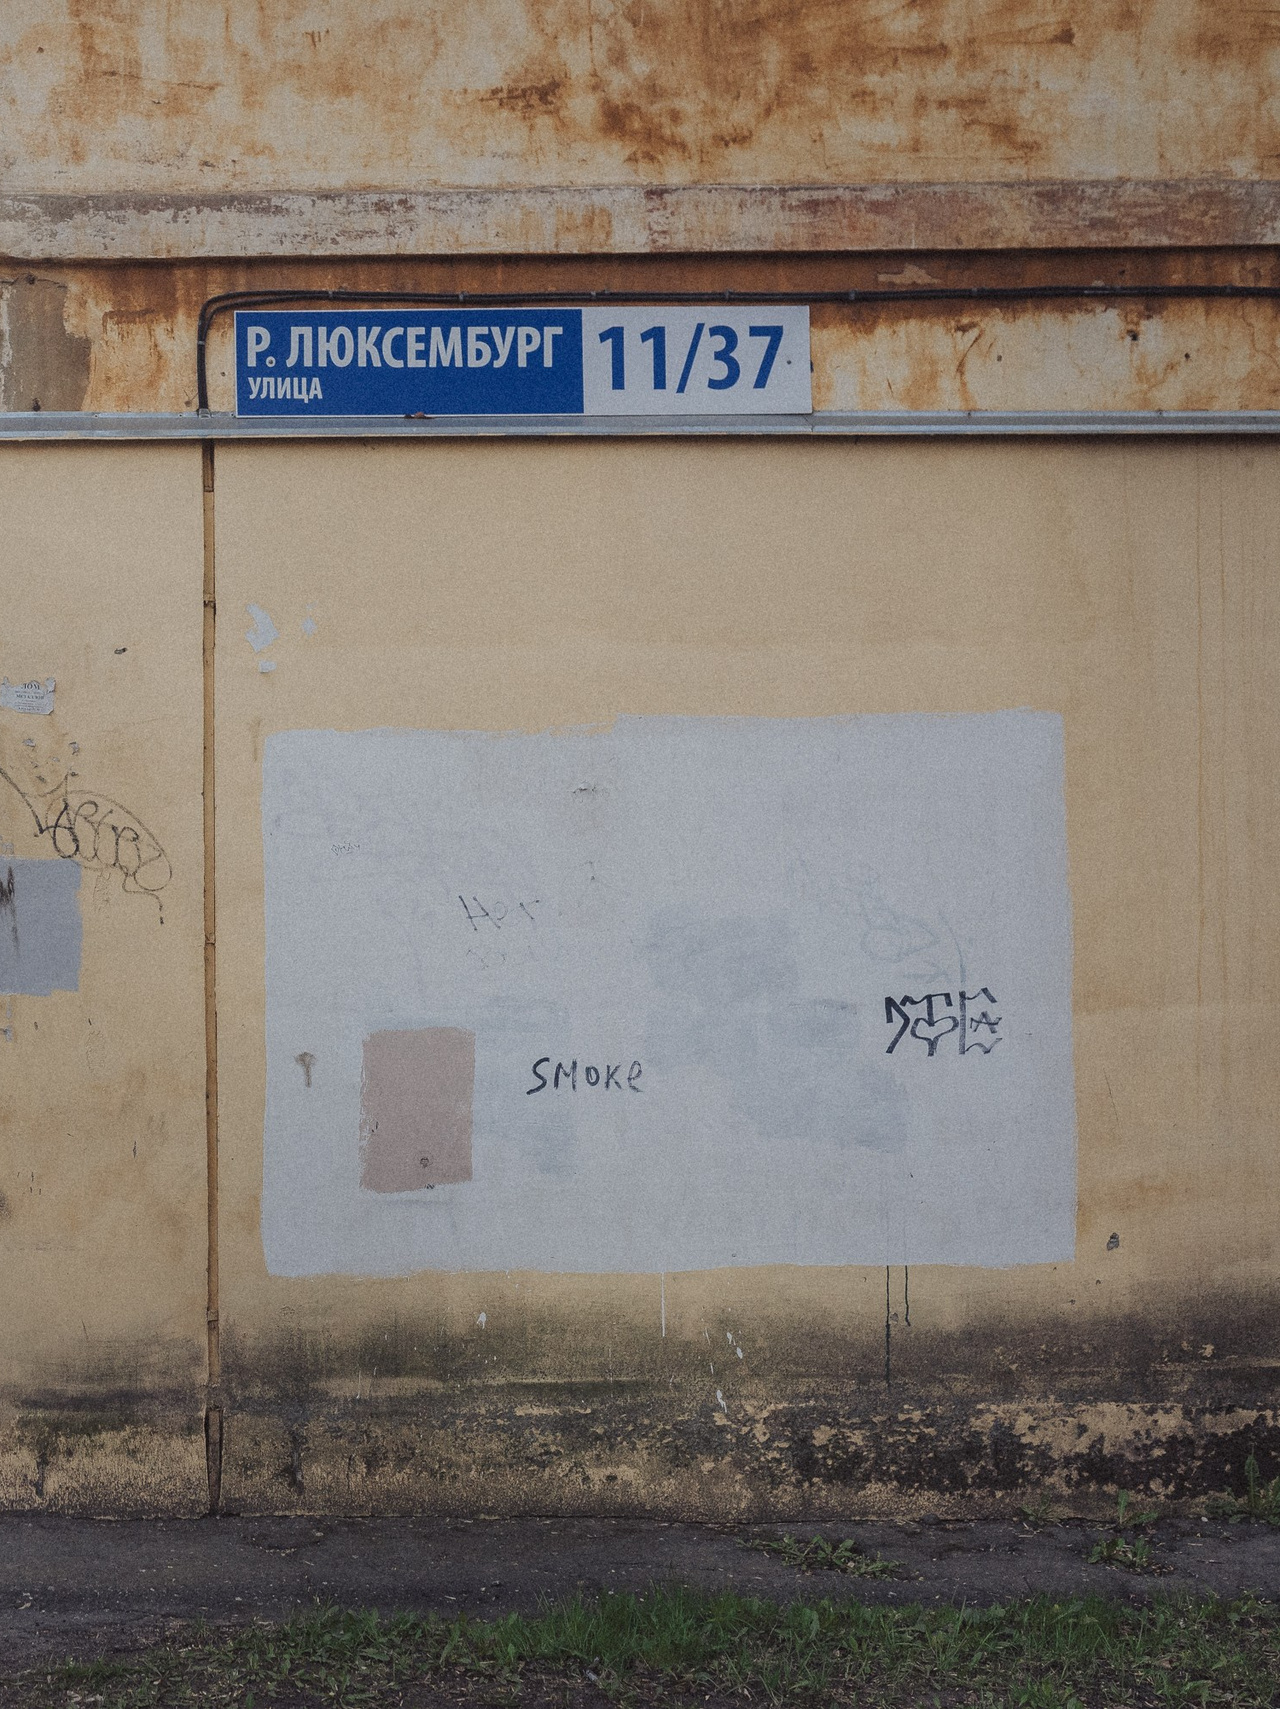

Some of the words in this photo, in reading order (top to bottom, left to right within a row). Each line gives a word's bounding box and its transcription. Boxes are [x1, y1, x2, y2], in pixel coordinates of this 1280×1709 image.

[247, 326, 276, 368] Р.
[286, 325, 563, 368] ЛЮКСЕМБУРГ
[598, 322, 784, 394] 11/37
[248, 376, 323, 404] УЛИЦА
